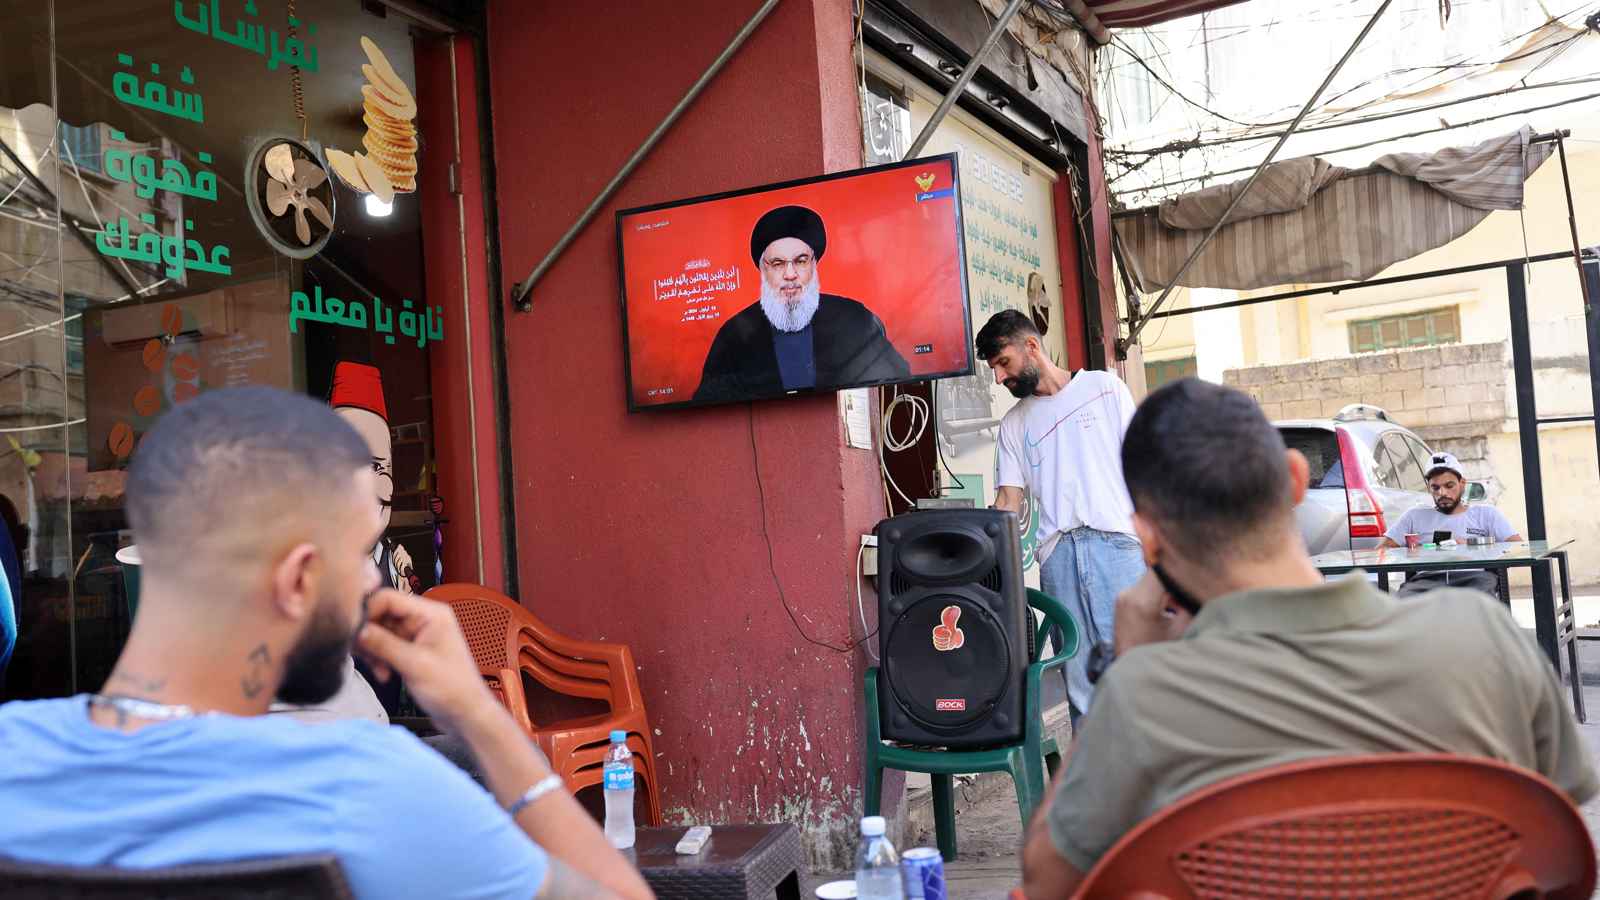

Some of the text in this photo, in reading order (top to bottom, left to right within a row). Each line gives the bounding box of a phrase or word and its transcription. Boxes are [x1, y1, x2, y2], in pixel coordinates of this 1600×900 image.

[112, 53, 204, 123] شفة
[103, 128, 217, 201] قهوة
[95, 213, 232, 280] عذوقك
[289, 285, 444, 348] نارة يا معلم
[937, 701, 964, 709] BOCK
